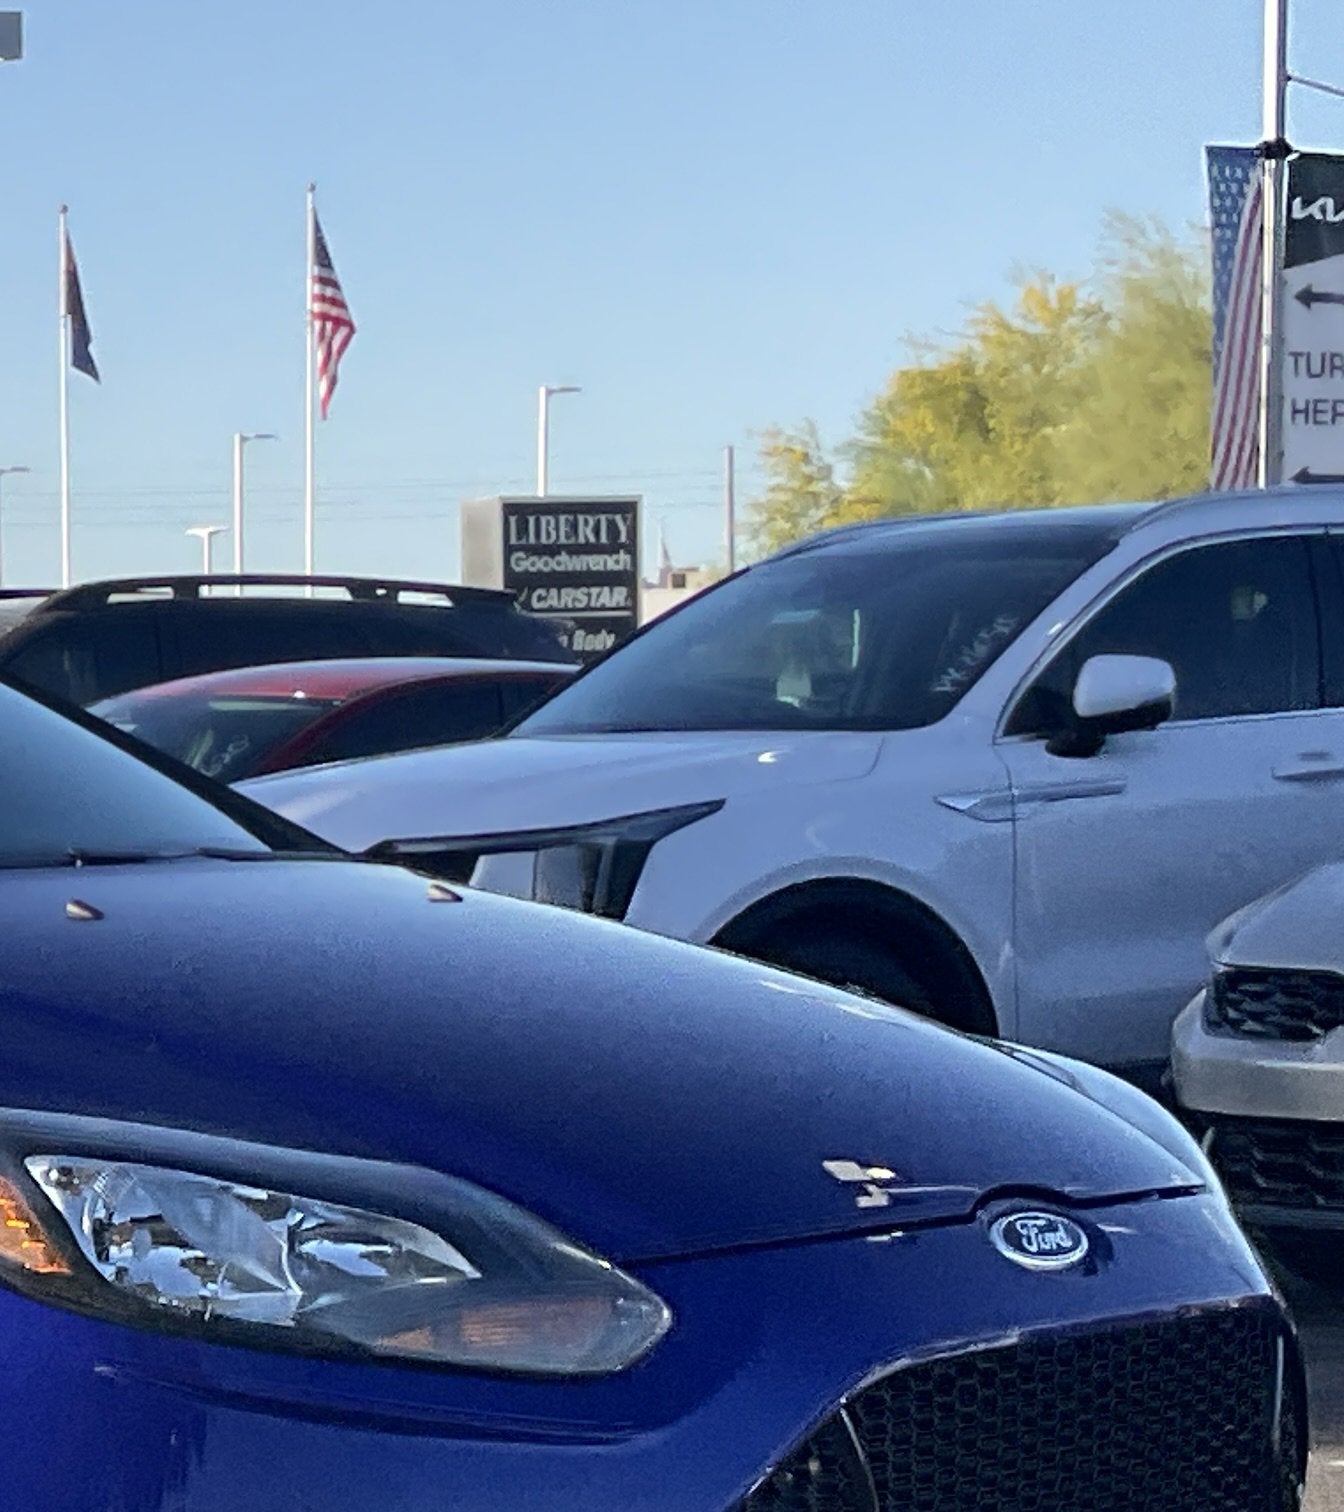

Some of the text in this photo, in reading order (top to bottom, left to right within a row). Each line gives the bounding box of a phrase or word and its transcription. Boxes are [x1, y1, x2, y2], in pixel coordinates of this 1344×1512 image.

[508, 513, 632, 544] LIBERTY
[510, 549, 631, 572] Goodwrench
[531, 586, 628, 609] CARSTAR
[1015, 1219, 1073, 1252] Ford
